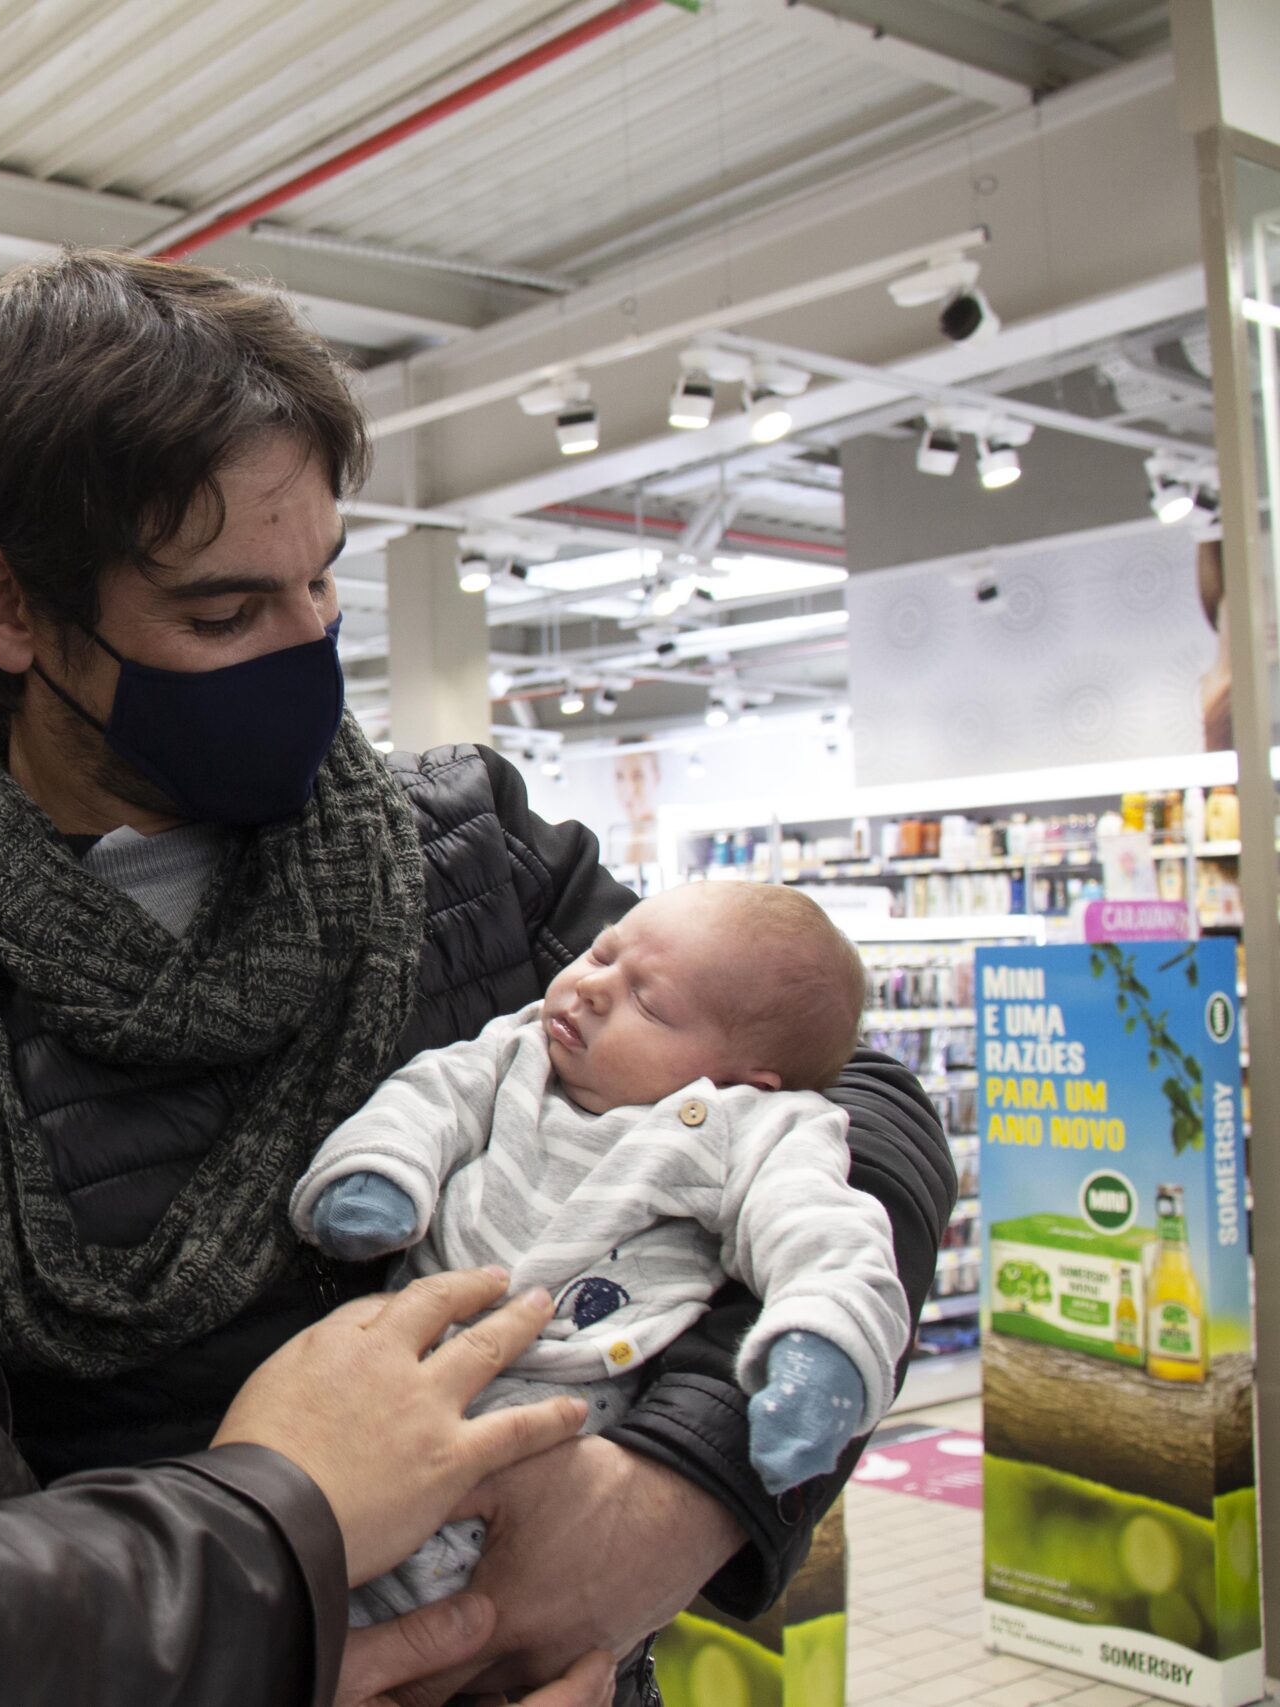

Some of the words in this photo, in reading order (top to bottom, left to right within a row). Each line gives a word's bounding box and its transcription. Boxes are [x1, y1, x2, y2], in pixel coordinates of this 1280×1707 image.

[982, 965, 1045, 1000] MINI
[984, 1005, 999, 1036] E
[1005, 1004, 1065, 1037] UMA
[985, 1036, 1085, 1074] RAZÕES
[986, 1077, 1058, 1109] PARA
[1065, 1079, 1107, 1112] UM
[987, 1114, 1043, 1146] ANO
[1051, 1116, 1126, 1152] NOVO
[1214, 1081, 1239, 1246] SOMERSBY
[1089, 1188, 1128, 1213] MINI
[1100, 1643, 1194, 1686] SOMERSBY
